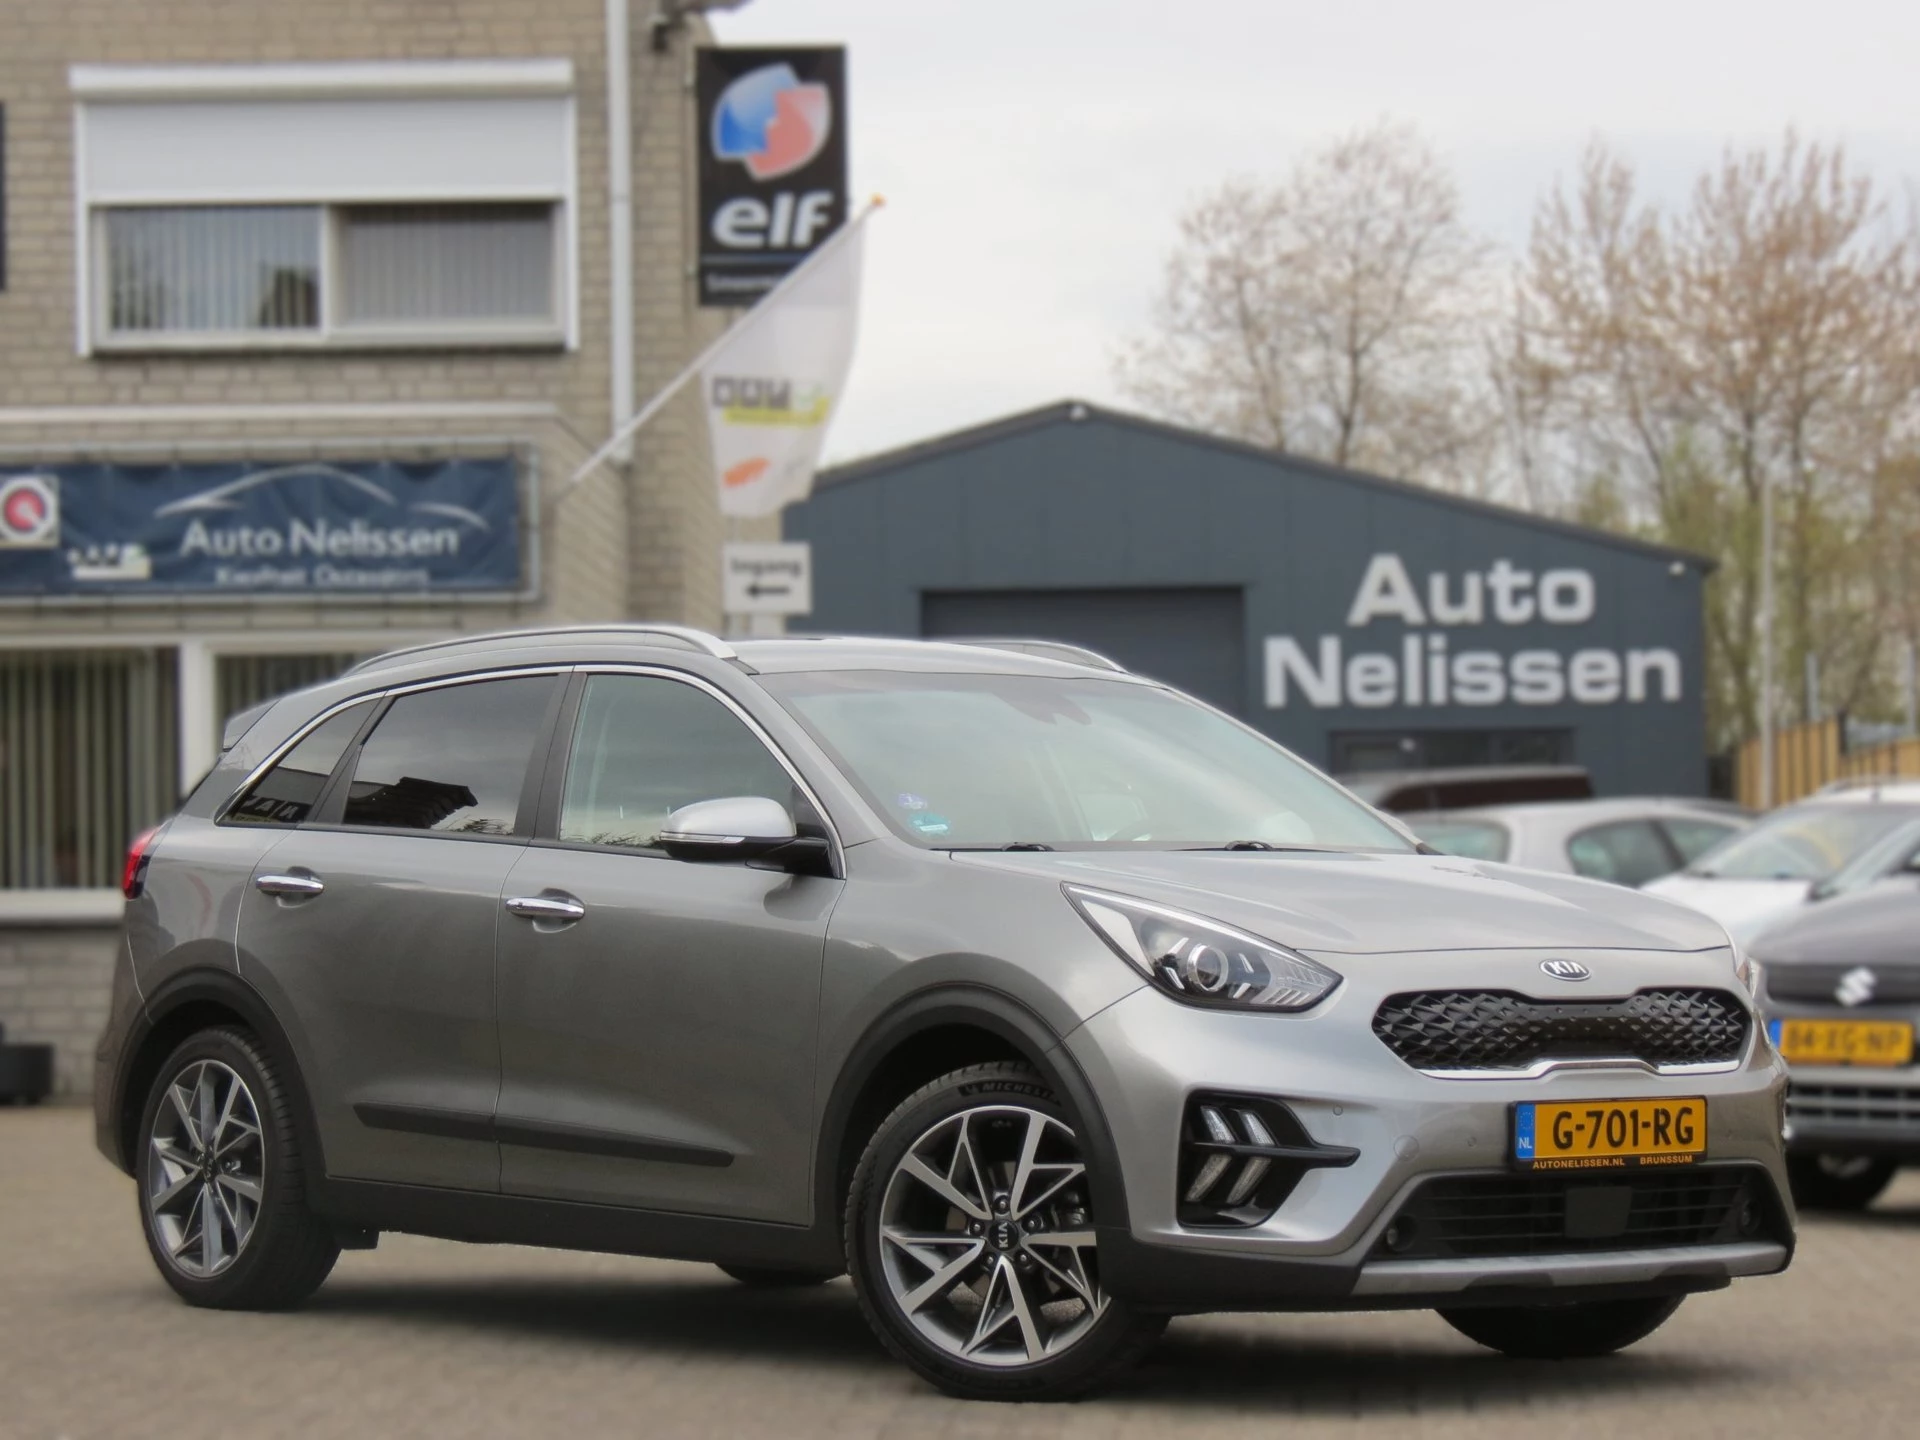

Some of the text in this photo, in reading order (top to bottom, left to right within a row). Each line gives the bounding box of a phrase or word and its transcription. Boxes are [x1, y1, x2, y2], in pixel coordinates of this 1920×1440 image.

[711, 190, 834, 249] elf
[180, 519, 459, 556] Auto Nelissen
[1346, 553, 1596, 626] Auto
[1263, 634, 1682, 709] Nelissen
[1547, 961, 1587, 975] KIA
[1518, 1136, 1533, 1150] NL
[1552, 1106, 1694, 1150] G-701-RG
[1532, 1154, 1693, 1170] AUTONELISSEN.NL BRUNSSUM
[998, 1222, 1009, 1248] KIA
